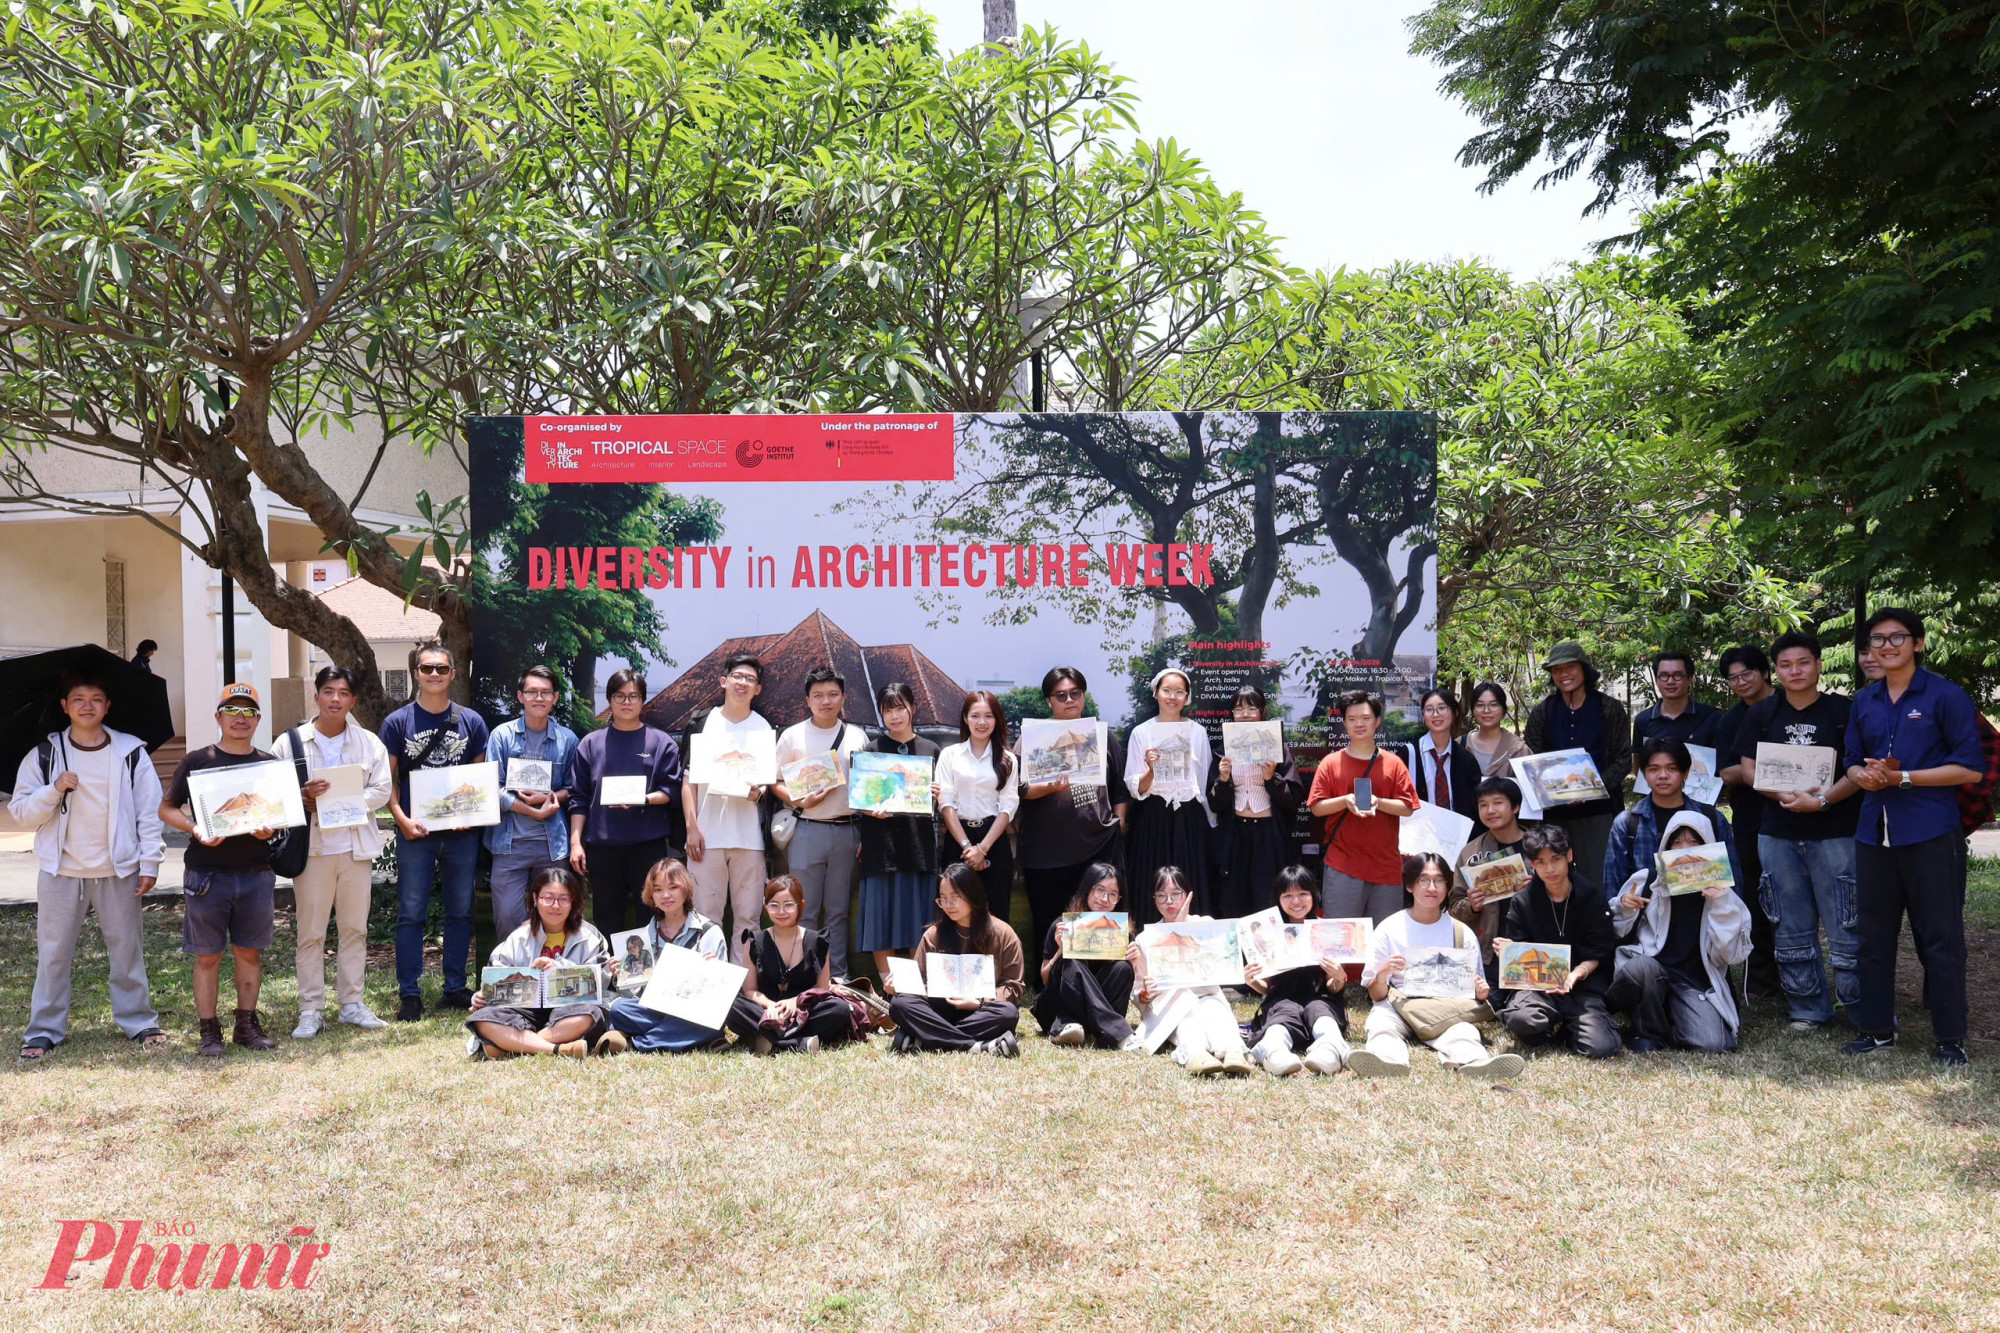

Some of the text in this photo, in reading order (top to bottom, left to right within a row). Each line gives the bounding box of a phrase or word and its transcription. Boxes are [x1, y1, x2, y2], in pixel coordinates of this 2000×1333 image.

[540, 422, 622, 433] Co-organised by
[821, 421, 938, 432] Under the patronage of
[591, 440, 727, 455] TROPICAL SPACE
[591, 461, 635, 469] Architecture
[528, 543, 1215, 590] DIVERSITY in ARCHITECTURE WEEK
[1188, 640, 1271, 651] Main highlights
[1194, 661, 1224, 669] Diversity
[1221, 669, 1250, 677] opening
[1375, 676, 1402, 684] Tropical
[1196, 710, 1215, 718] Night
[1309, 725, 1333, 733] Design
